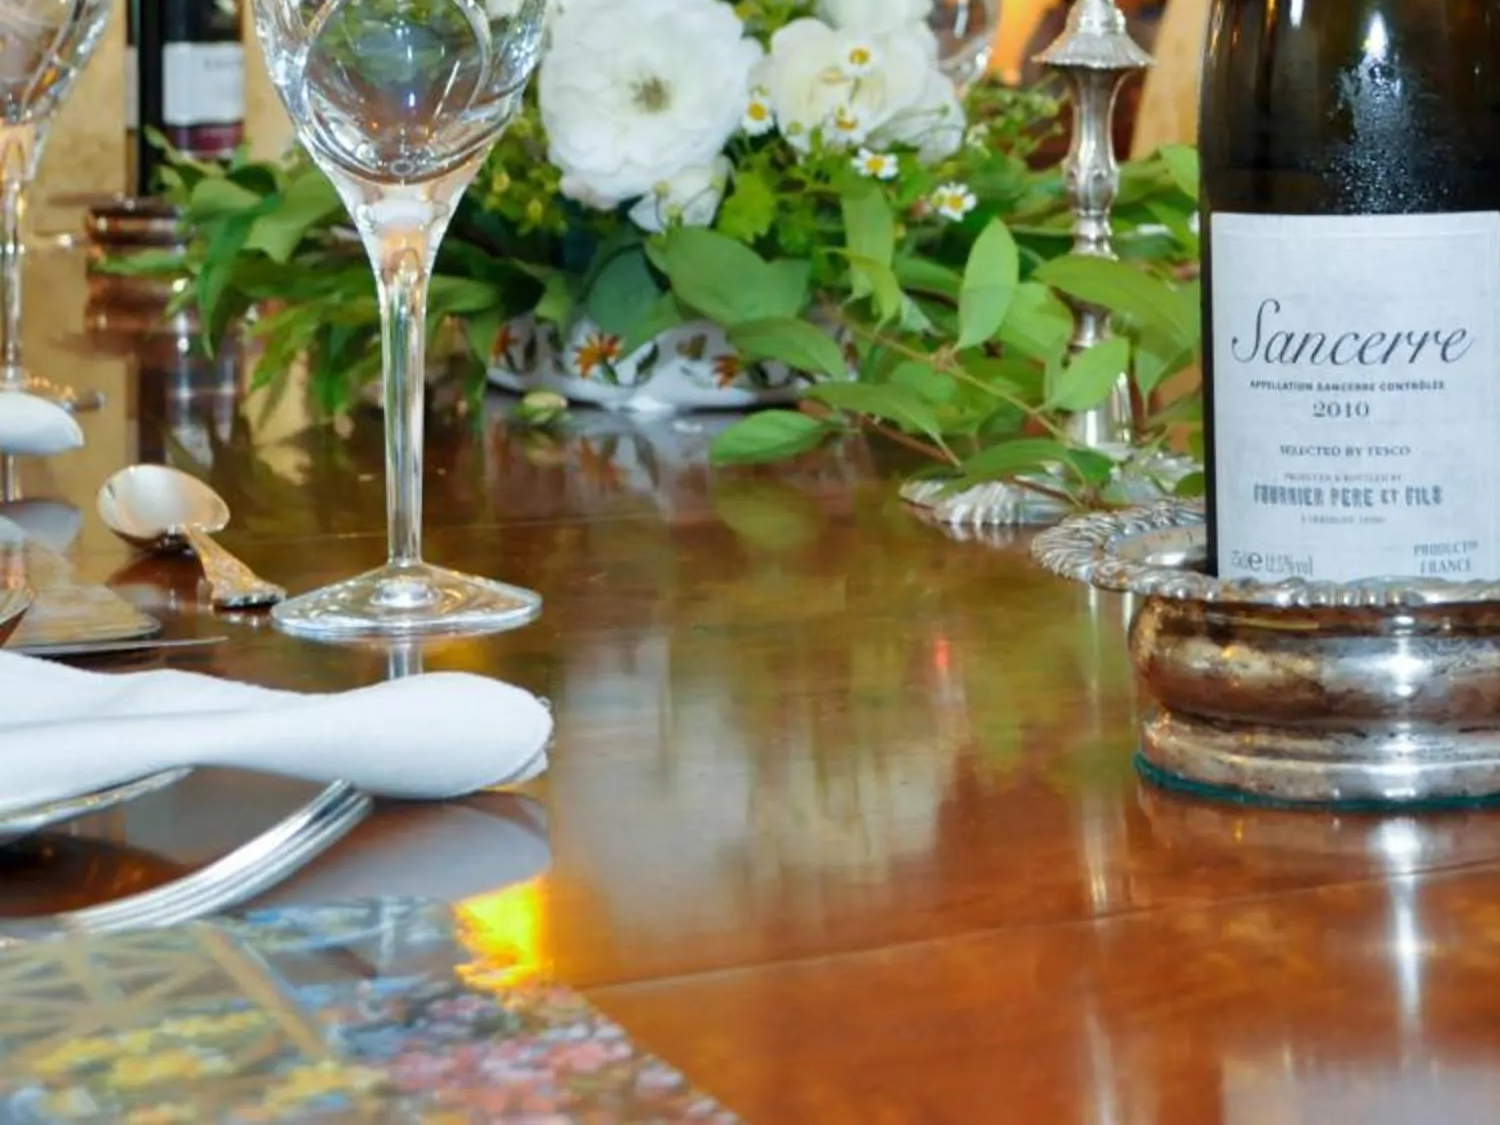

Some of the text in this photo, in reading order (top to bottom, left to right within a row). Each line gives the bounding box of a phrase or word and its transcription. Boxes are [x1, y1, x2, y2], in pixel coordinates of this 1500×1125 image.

[1231, 298, 1475, 366] Sancerre
[1249, 379, 1313, 391] APPELLATION
[1316, 380, 1376, 392] SANCERRE
[1311, 401, 1371, 419] 2010
[1279, 444, 1412, 457] SELECTED BY TESCO
